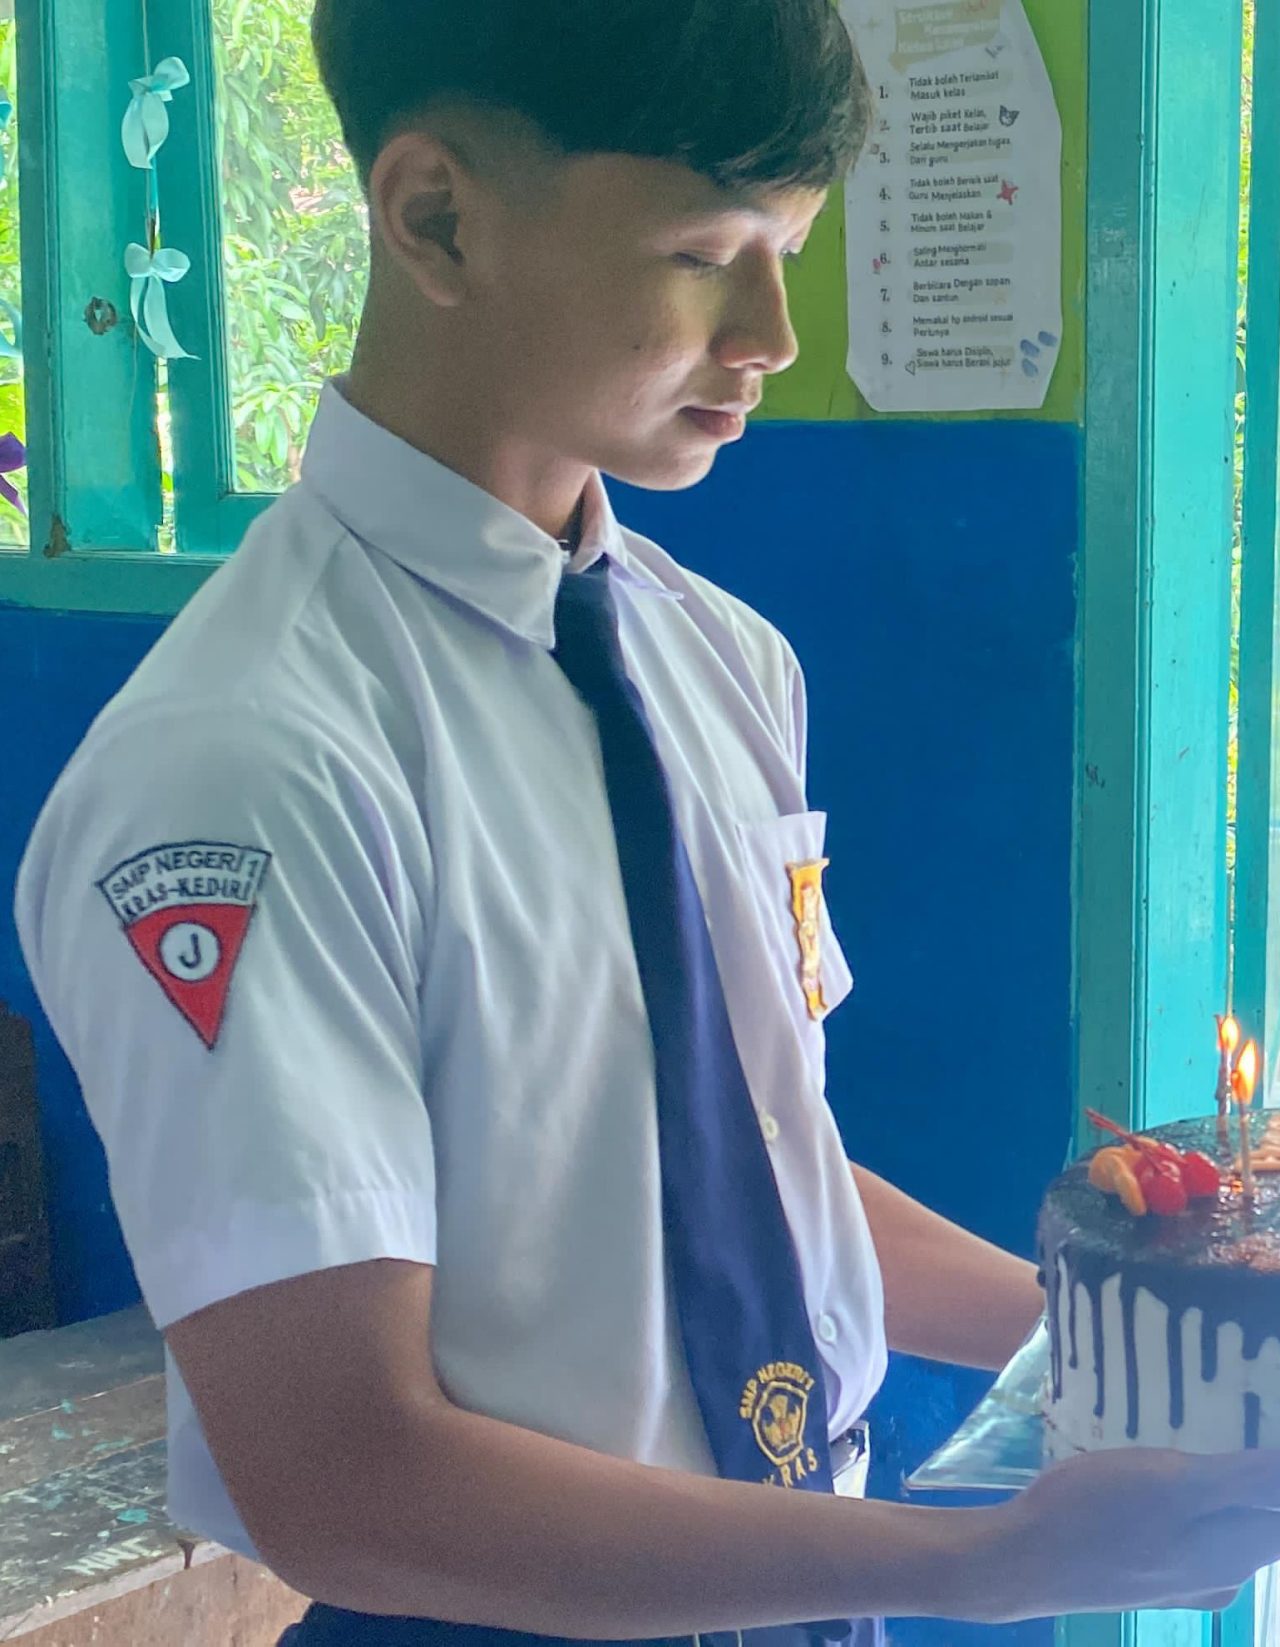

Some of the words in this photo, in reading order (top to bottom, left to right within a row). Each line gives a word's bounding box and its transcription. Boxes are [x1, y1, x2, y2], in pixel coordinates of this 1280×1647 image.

[909, 77, 932, 88] Tidak
[910, 89, 940, 100] Masuk
[911, 110, 937, 122] Wajib
[909, 123, 938, 135] Tertib
[940, 122, 962, 133] saat
[910, 177, 931, 188] Tidak
[911, 211, 933, 222] Tidak
[112, 862, 150, 899] SMP
[156, 851, 241, 874] NEGERI
[247, 859, 259, 878] 1
[178, 933, 201, 969] J
